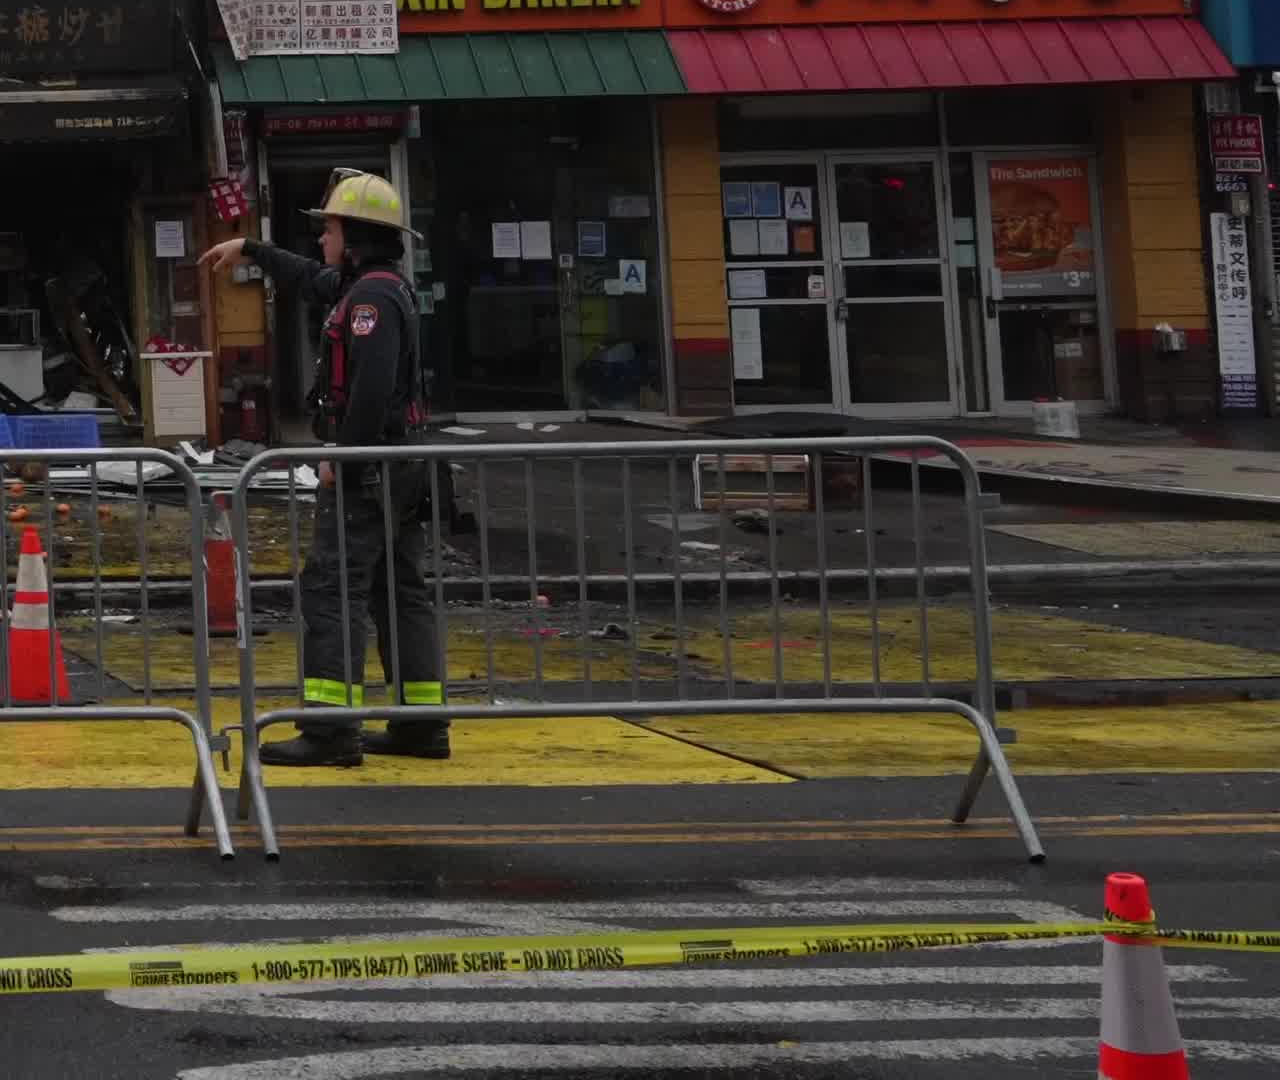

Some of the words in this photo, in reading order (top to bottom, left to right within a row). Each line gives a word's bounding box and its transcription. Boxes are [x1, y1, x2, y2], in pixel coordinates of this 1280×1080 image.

[790, 191, 807, 209] A
[625, 264, 641, 284] A
[252, 958, 361, 981] 1-800-577-TIPS
[414, 954, 457, 976] CRIME
[462, 952, 506, 972] SCENE
[523, 951, 542, 970] DO
[547, 949, 573, 970] NOT
[576, 947, 624, 968] CROSS
[26, 968, 72, 989] CROSS
